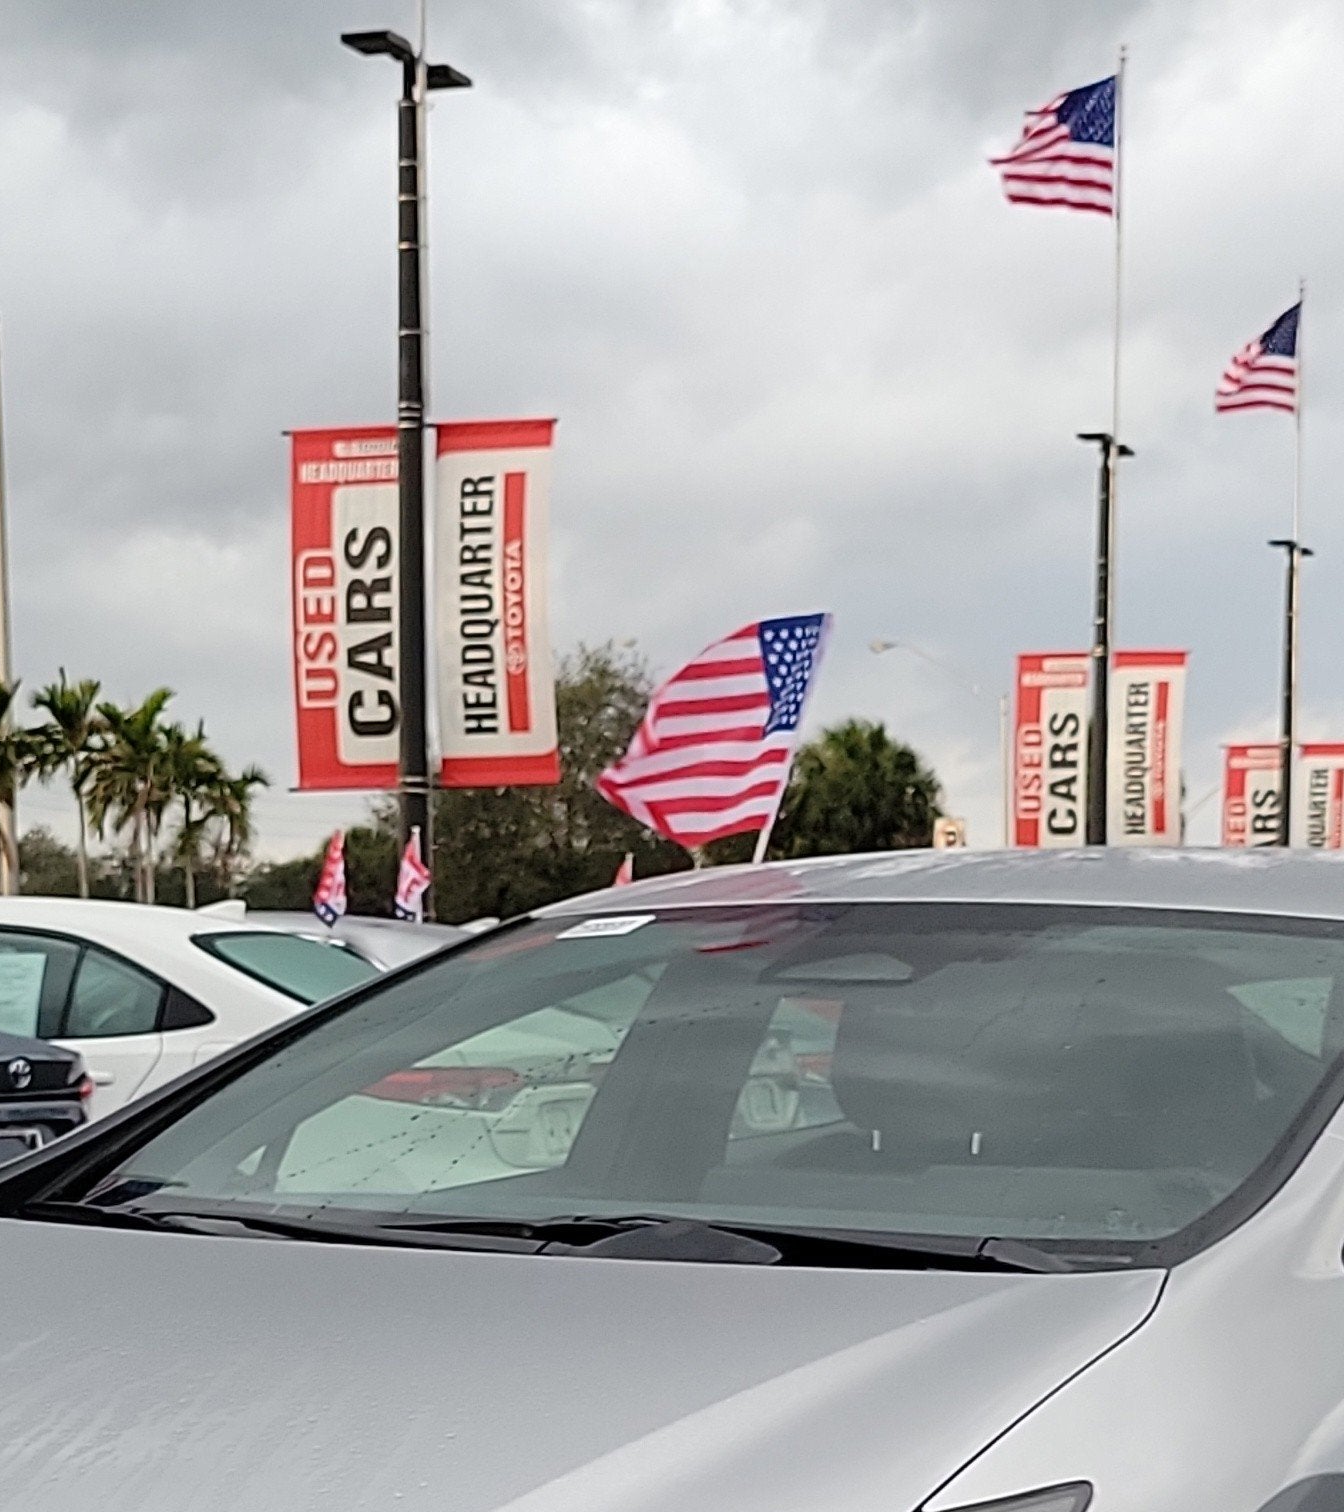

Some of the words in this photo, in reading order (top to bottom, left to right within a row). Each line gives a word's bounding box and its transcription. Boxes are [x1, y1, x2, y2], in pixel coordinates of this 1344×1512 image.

[303, 555, 338, 702] USED
[344, 526, 398, 737] CARS
[460, 474, 501, 736] HEADQUARTER
[505, 538, 524, 642] TOYOTA
[1022, 728, 1043, 815] USED
[1047, 712, 1080, 837] CARS
[1123, 681, 1150, 837] HEADQUARTER
